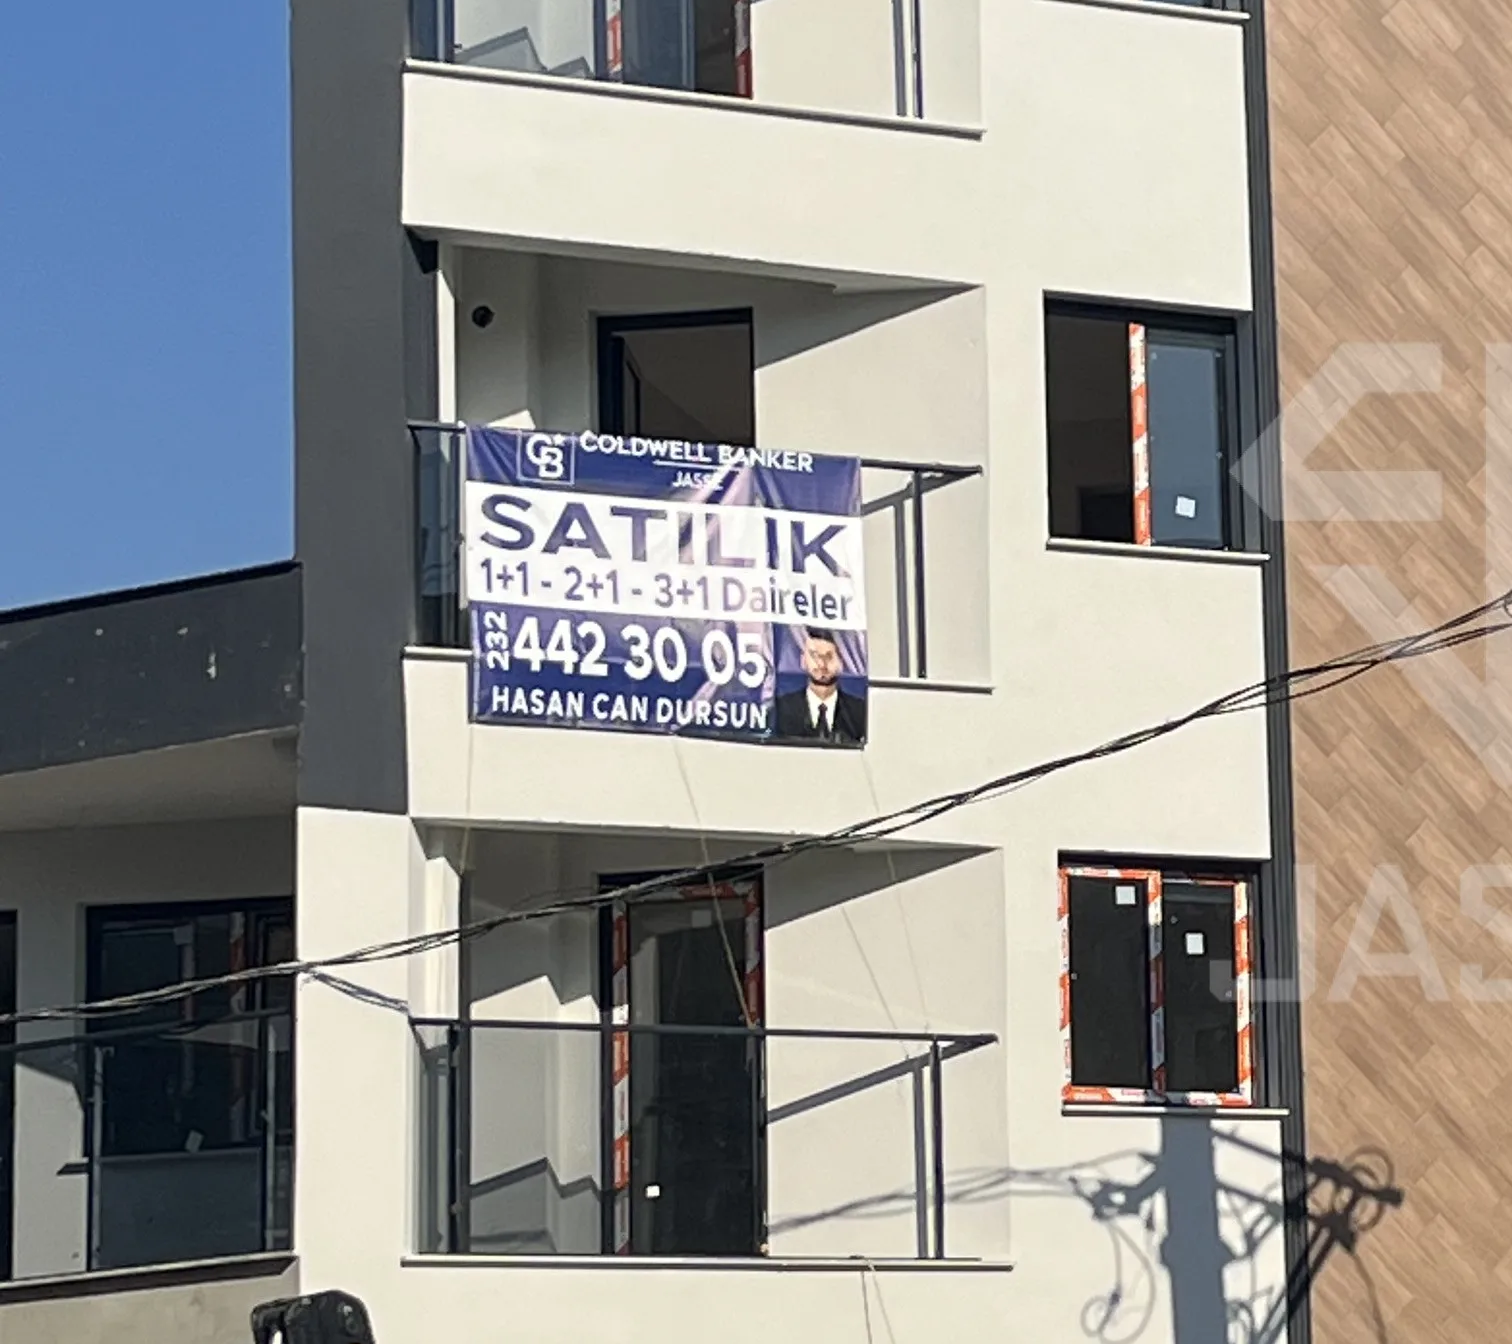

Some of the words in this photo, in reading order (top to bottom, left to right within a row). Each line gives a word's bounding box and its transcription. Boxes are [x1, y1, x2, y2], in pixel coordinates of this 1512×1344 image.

[580, 430, 712, 463] COLDWELL
[718, 444, 813, 473] BANKER
[673, 471, 723, 490] JASSE
[480, 494, 852, 579] SATILIK
[480, 558, 529, 597] 1+1
[564, 566, 619, 604] 2+1
[654, 573, 710, 611] 3+1
[722, 575, 853, 621] Daireler
[484, 610, 510, 671] 232
[513, 616, 609, 677] 442
[621, 623, 688, 683] 30
[701, 629, 768, 689] 05
[492, 685, 584, 718] HASAN
[592, 692, 649, 722] CAN
[656, 697, 768, 730] DURSUN
